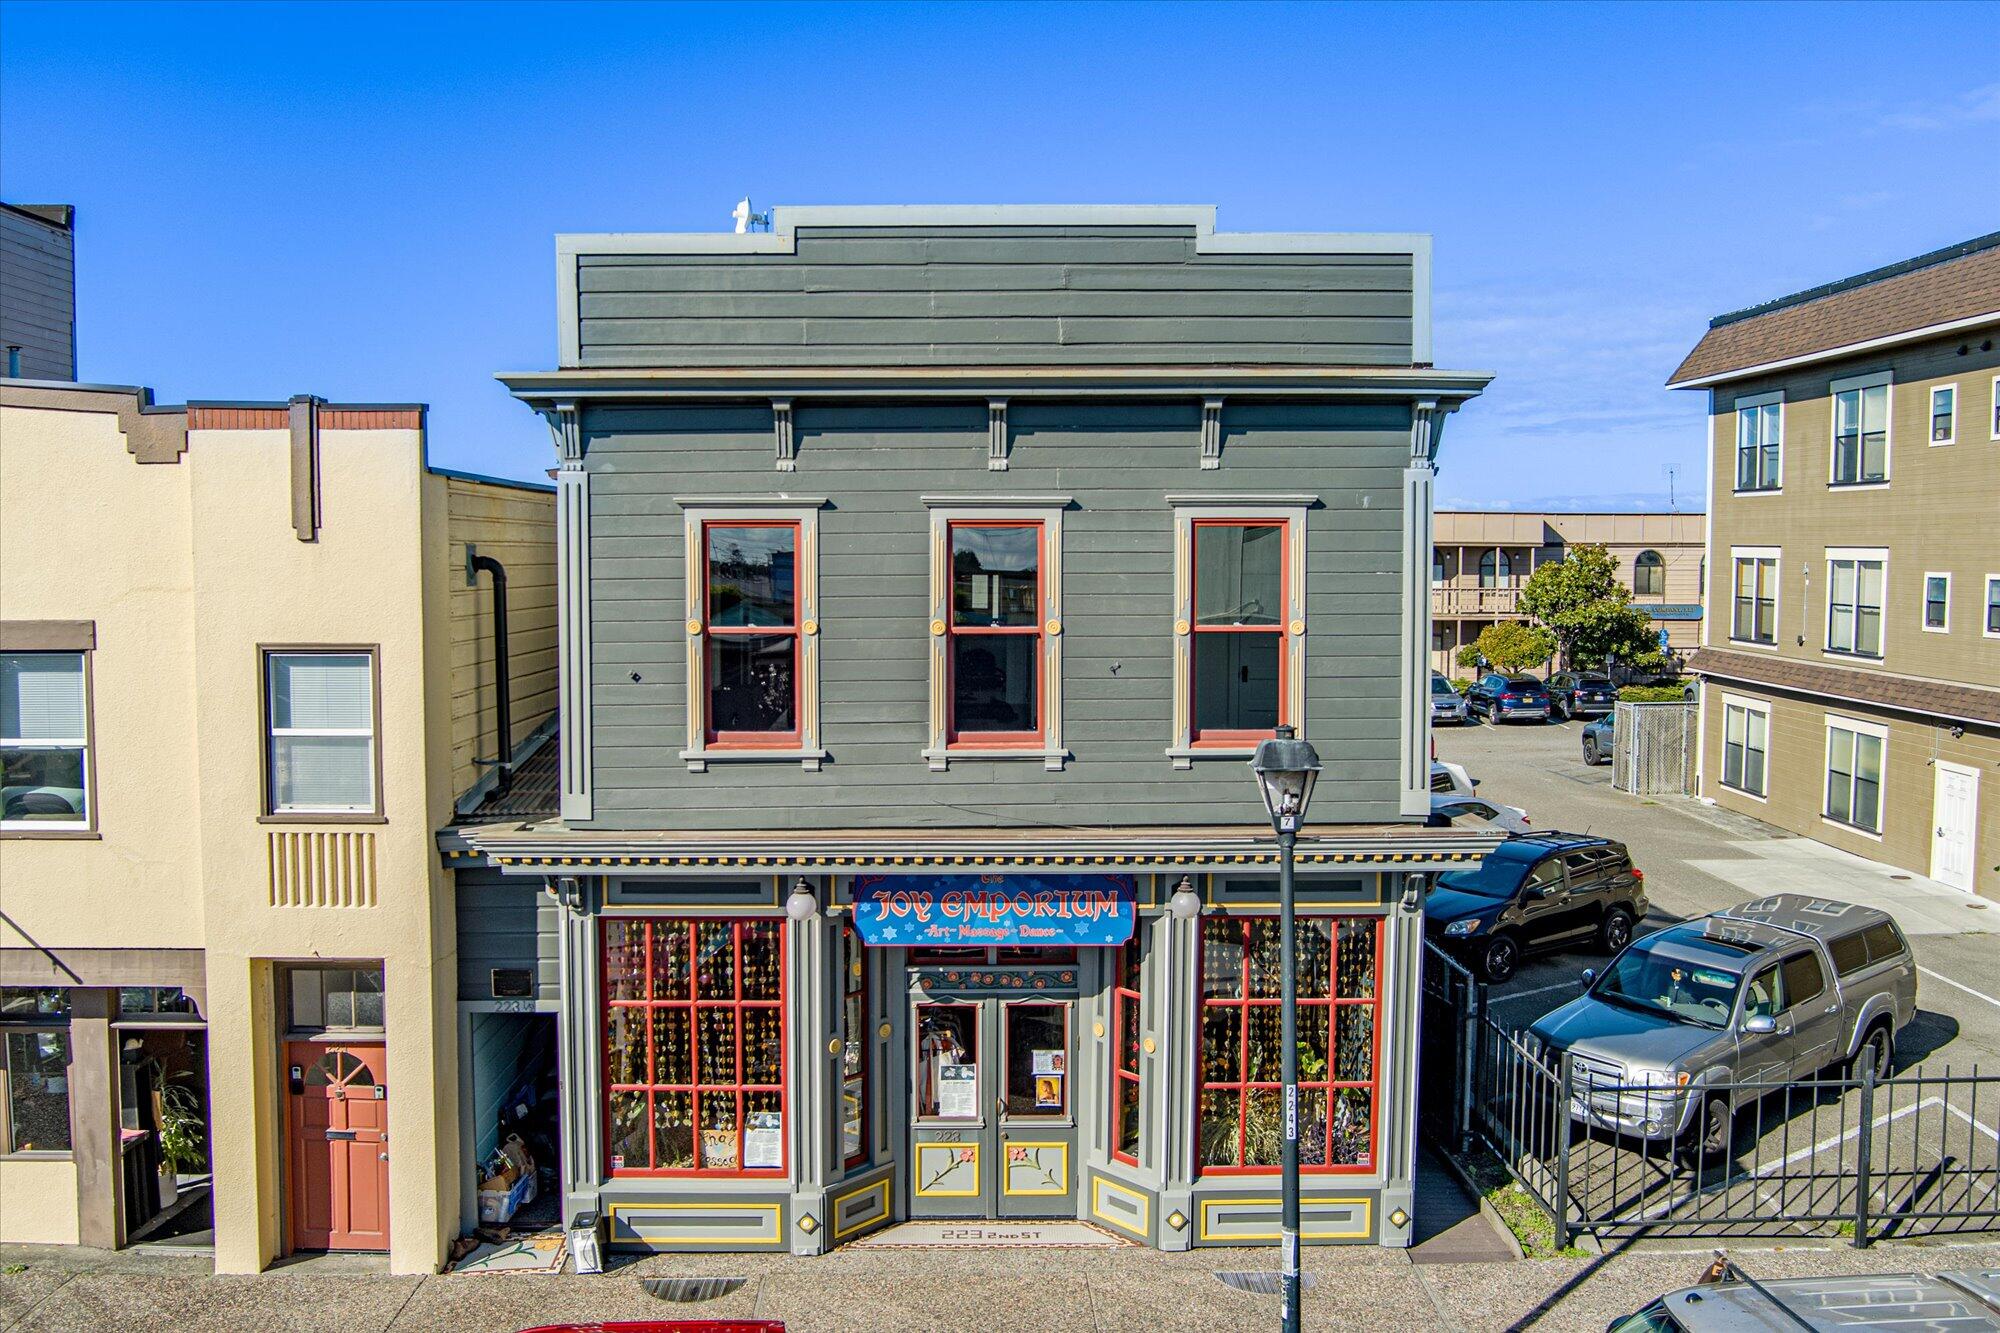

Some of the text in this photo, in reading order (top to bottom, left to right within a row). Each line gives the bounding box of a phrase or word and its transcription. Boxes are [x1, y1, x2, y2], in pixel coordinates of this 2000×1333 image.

[872, 890, 1119, 922] JOY EMPORIUM
[935, 1131, 961, 1143] 223
[942, 1229, 982, 1239] 223
